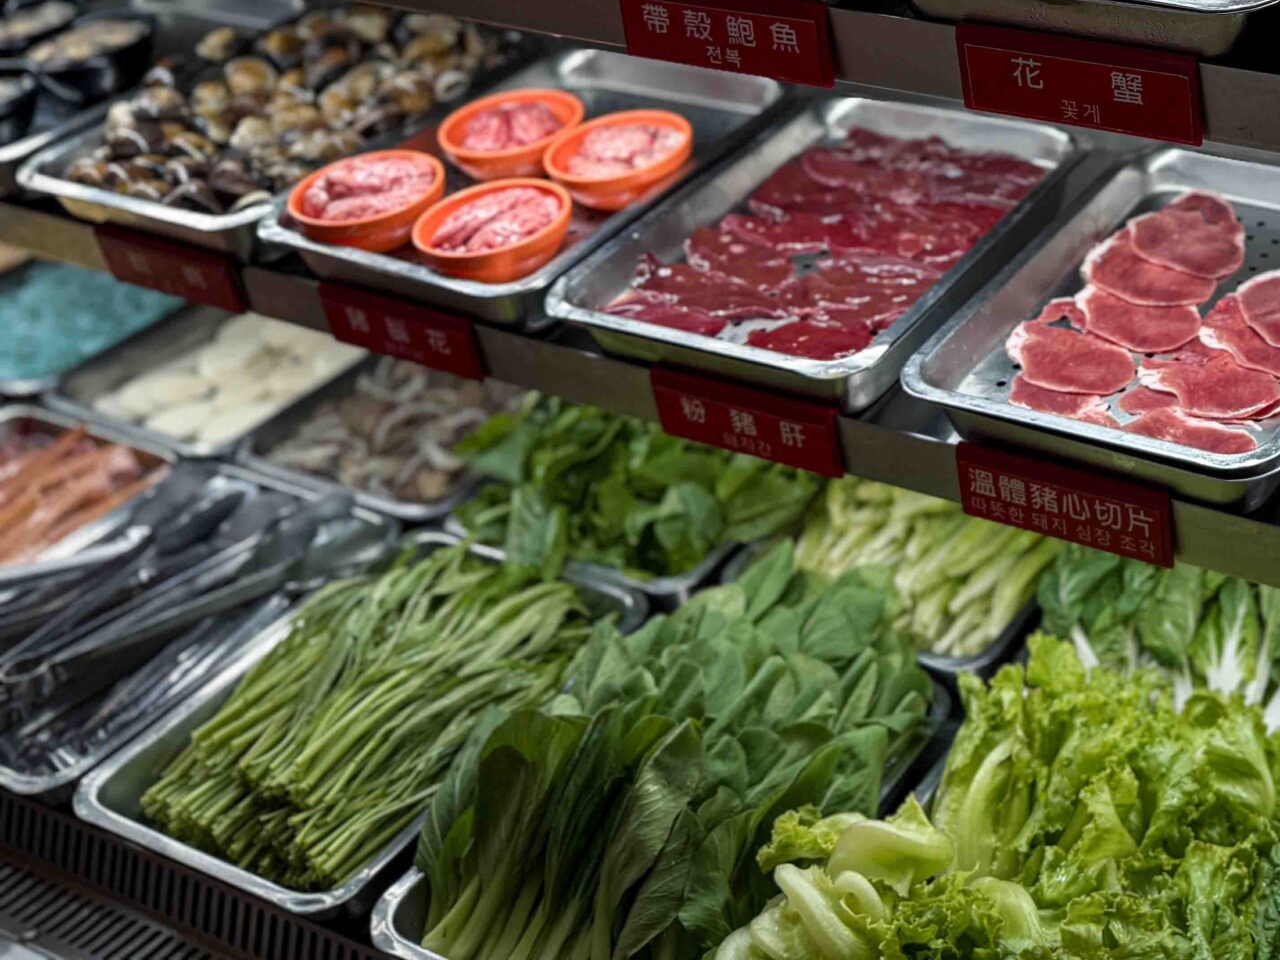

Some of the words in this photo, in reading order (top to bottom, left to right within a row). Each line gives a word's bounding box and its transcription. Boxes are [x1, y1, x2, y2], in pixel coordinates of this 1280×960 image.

[641, 3, 800, 54] 帶殼鮑魚
[705, 45, 742, 68] 전복
[1011, 57, 1144, 106] 花蟹
[1061, 100, 1101, 125] 꽃게
[968, 467, 1154, 539] 溫體豬心切片
